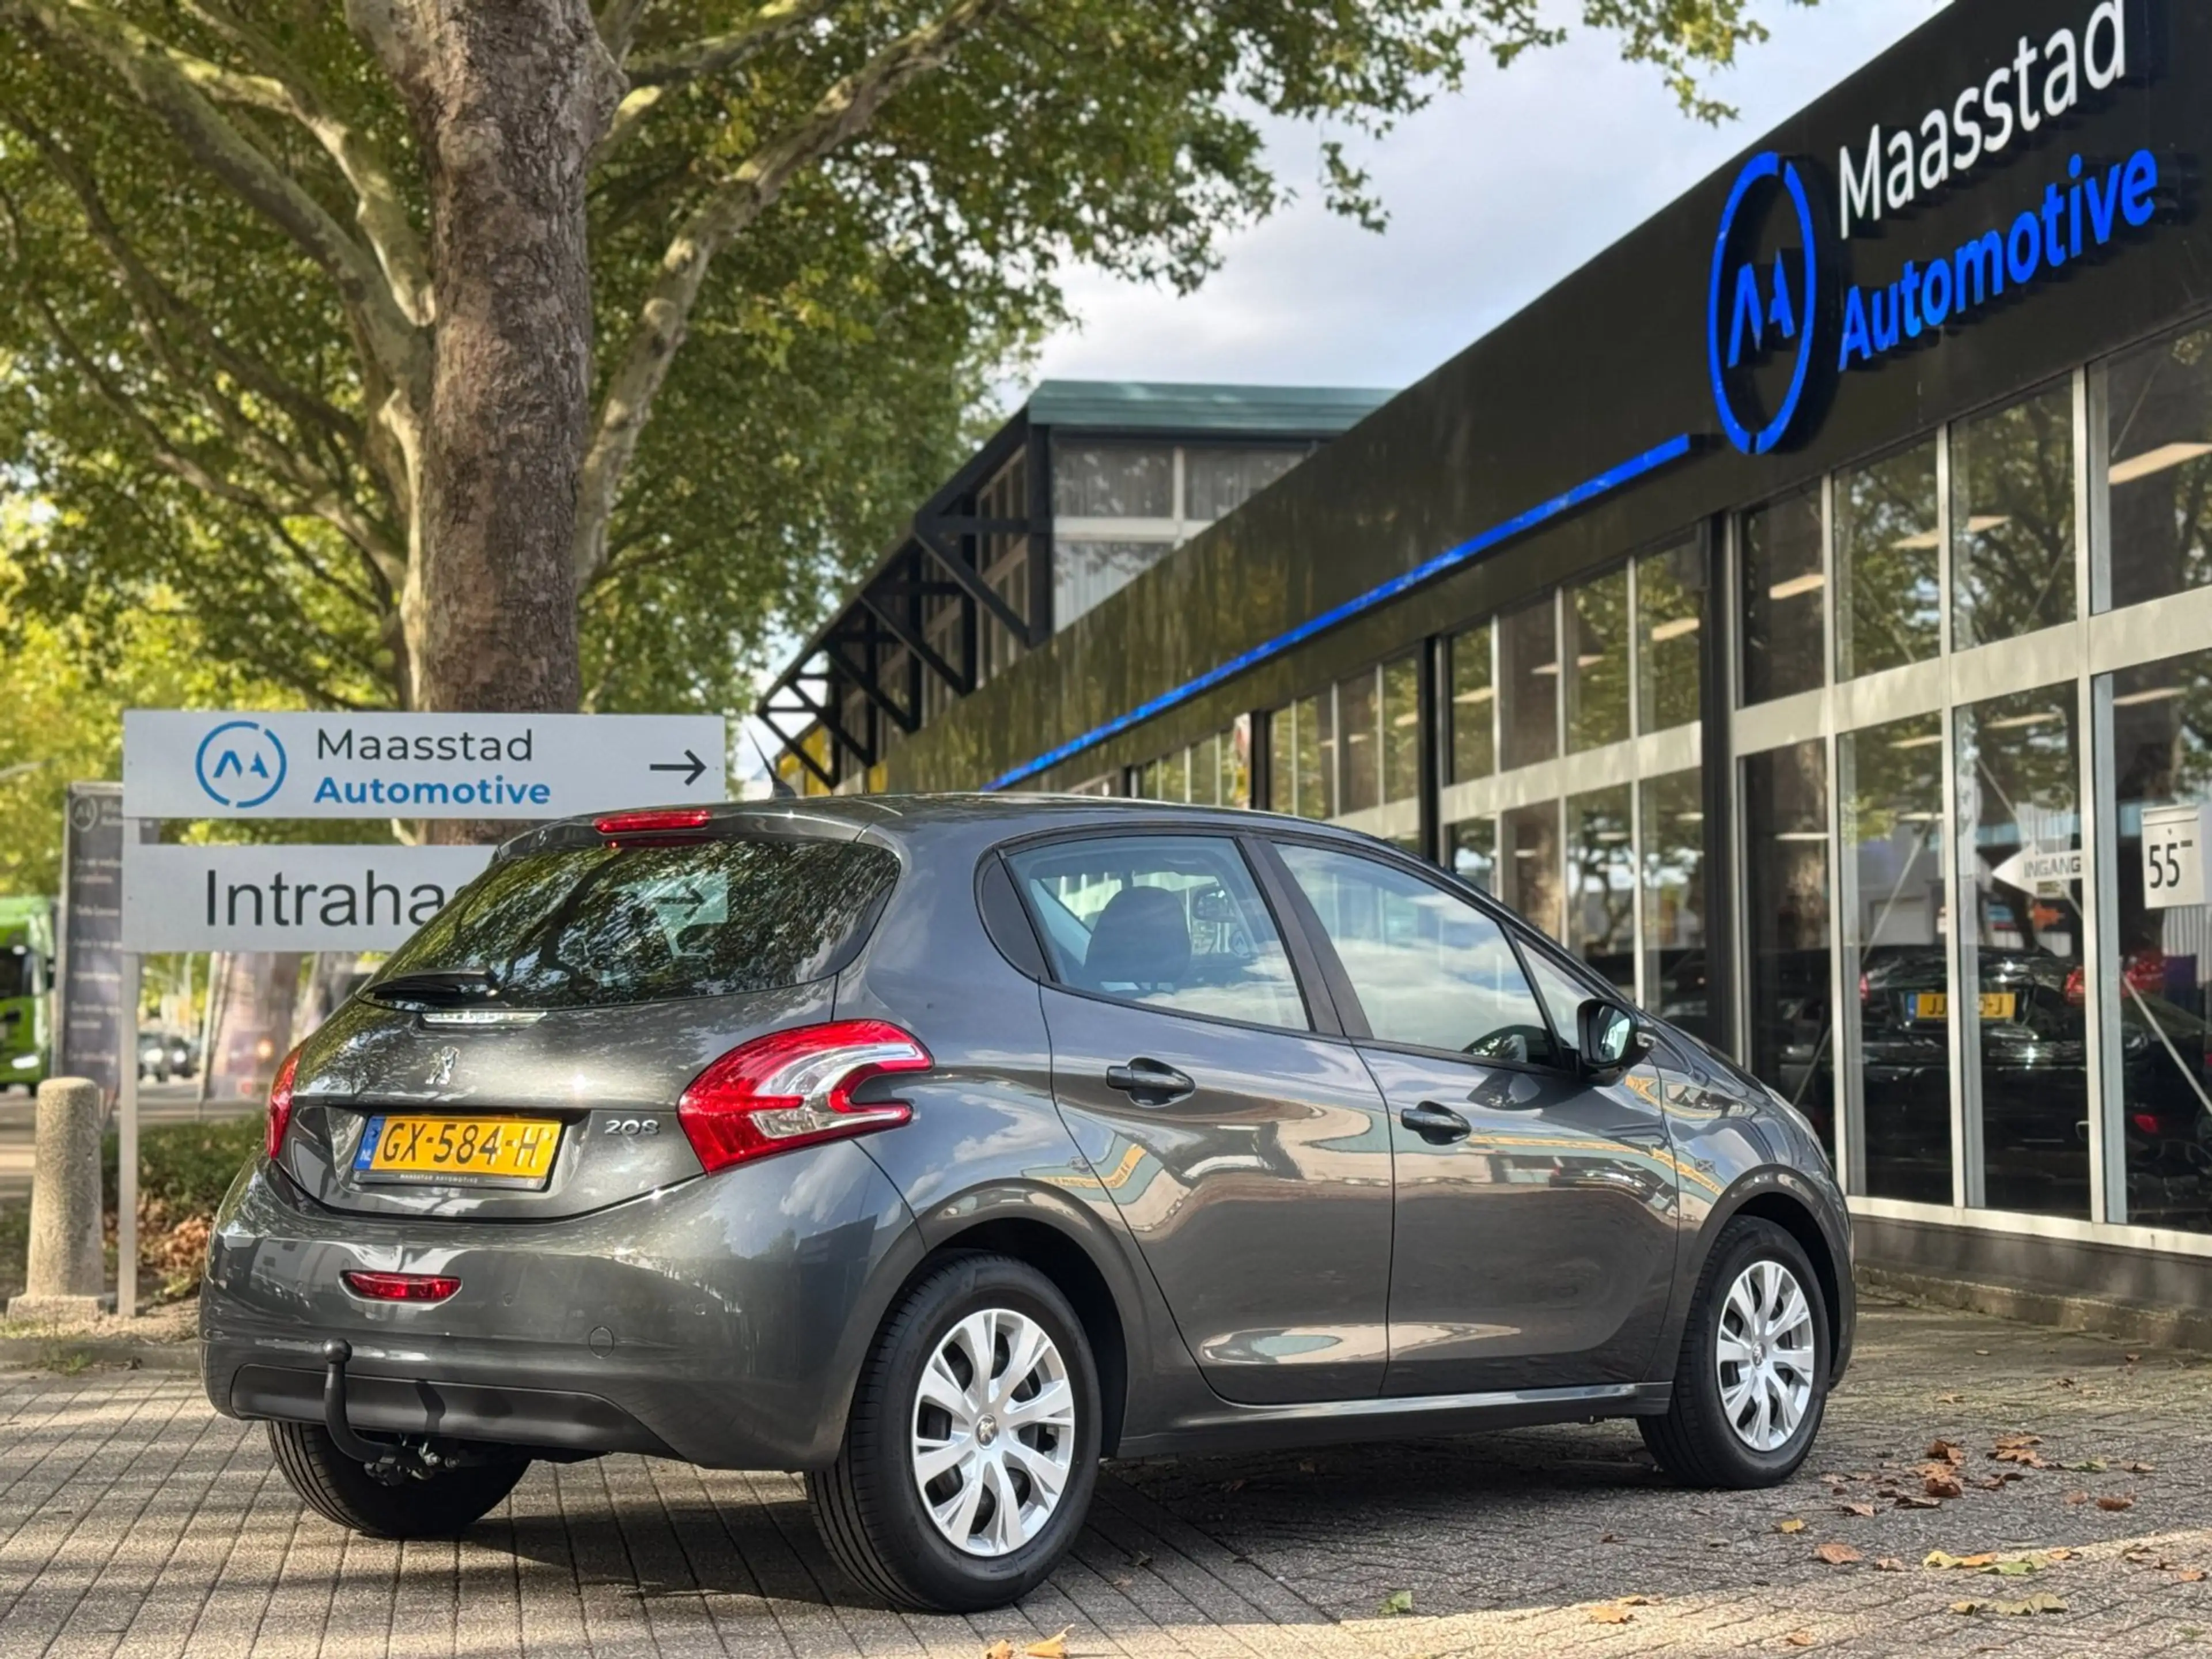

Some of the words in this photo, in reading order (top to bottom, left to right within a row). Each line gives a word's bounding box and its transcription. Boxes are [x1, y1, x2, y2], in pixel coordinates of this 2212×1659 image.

[1839, 0, 2125, 240] Maasstad
[1838, 149, 2158, 372] Automotive
[317, 729, 533, 762] Maasstad
[313, 775, 551, 804] Automotive
[2024, 856, 2081, 878] INGANG
[207, 870, 468, 926] Intraha
[382, 1123, 544, 1168] GX-584-H
[604, 1119, 660, 1135] 208
